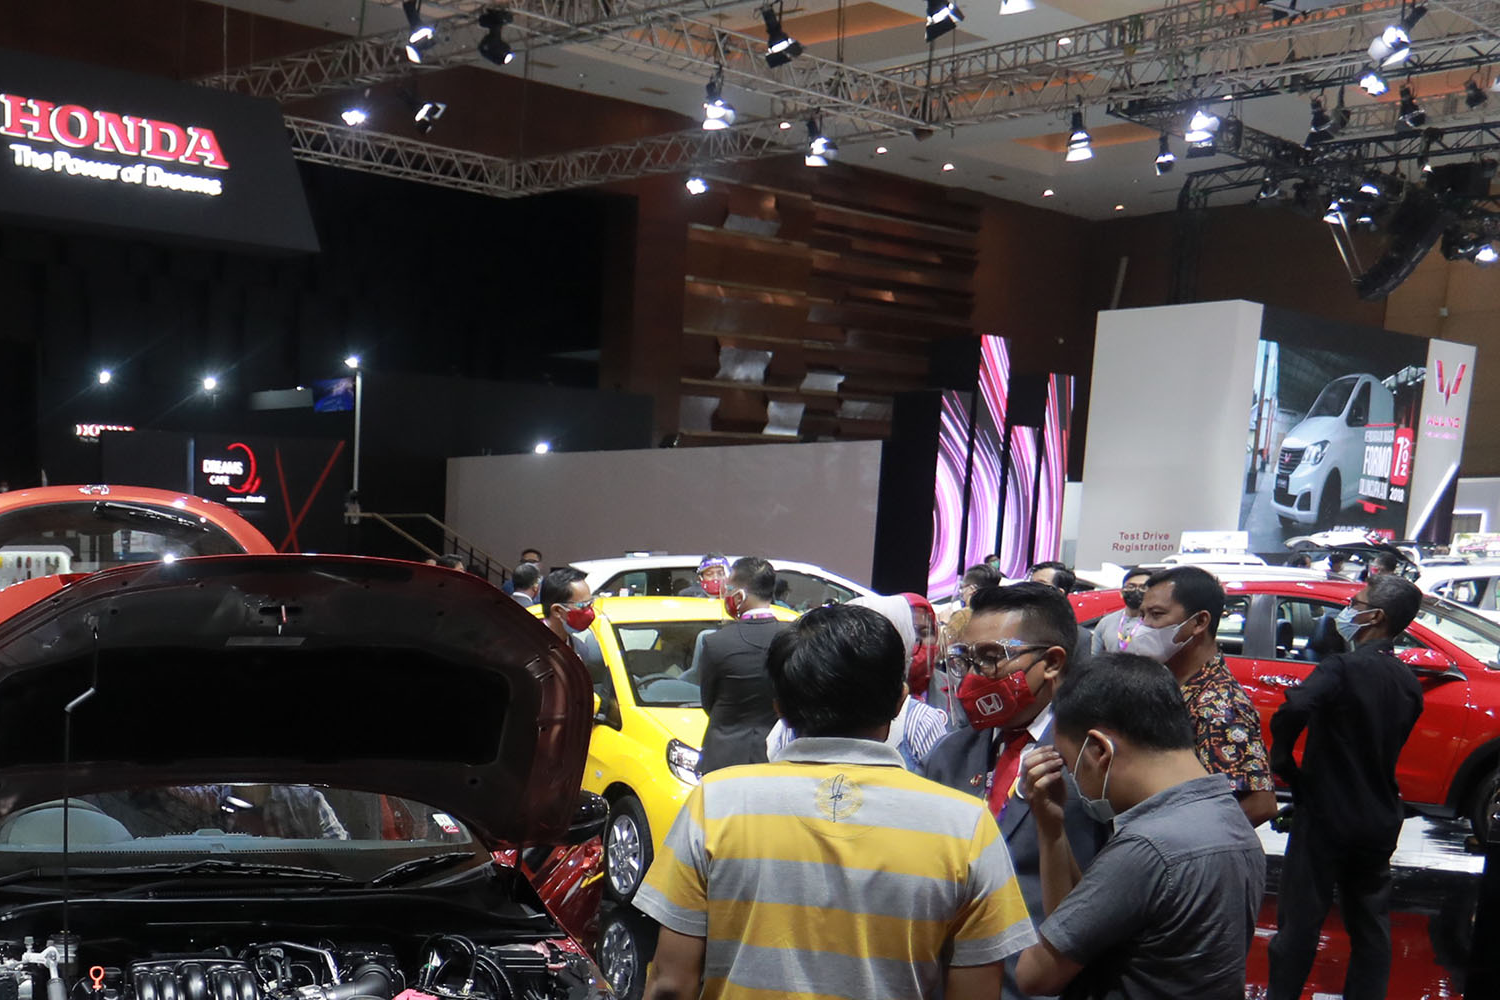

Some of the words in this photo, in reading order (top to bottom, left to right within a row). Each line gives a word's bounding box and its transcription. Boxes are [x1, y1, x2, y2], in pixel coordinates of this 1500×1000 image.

[0, 94, 230, 170] HONDA
[9, 144, 53, 171] The
[53, 151, 121, 180] Power
[121, 163, 146, 184] of
[202, 459, 244, 475] DREAMS
[1119, 531, 1140, 541] Test
[1142, 531, 1170, 541] Drive
[1112, 542, 1174, 553] Registration
